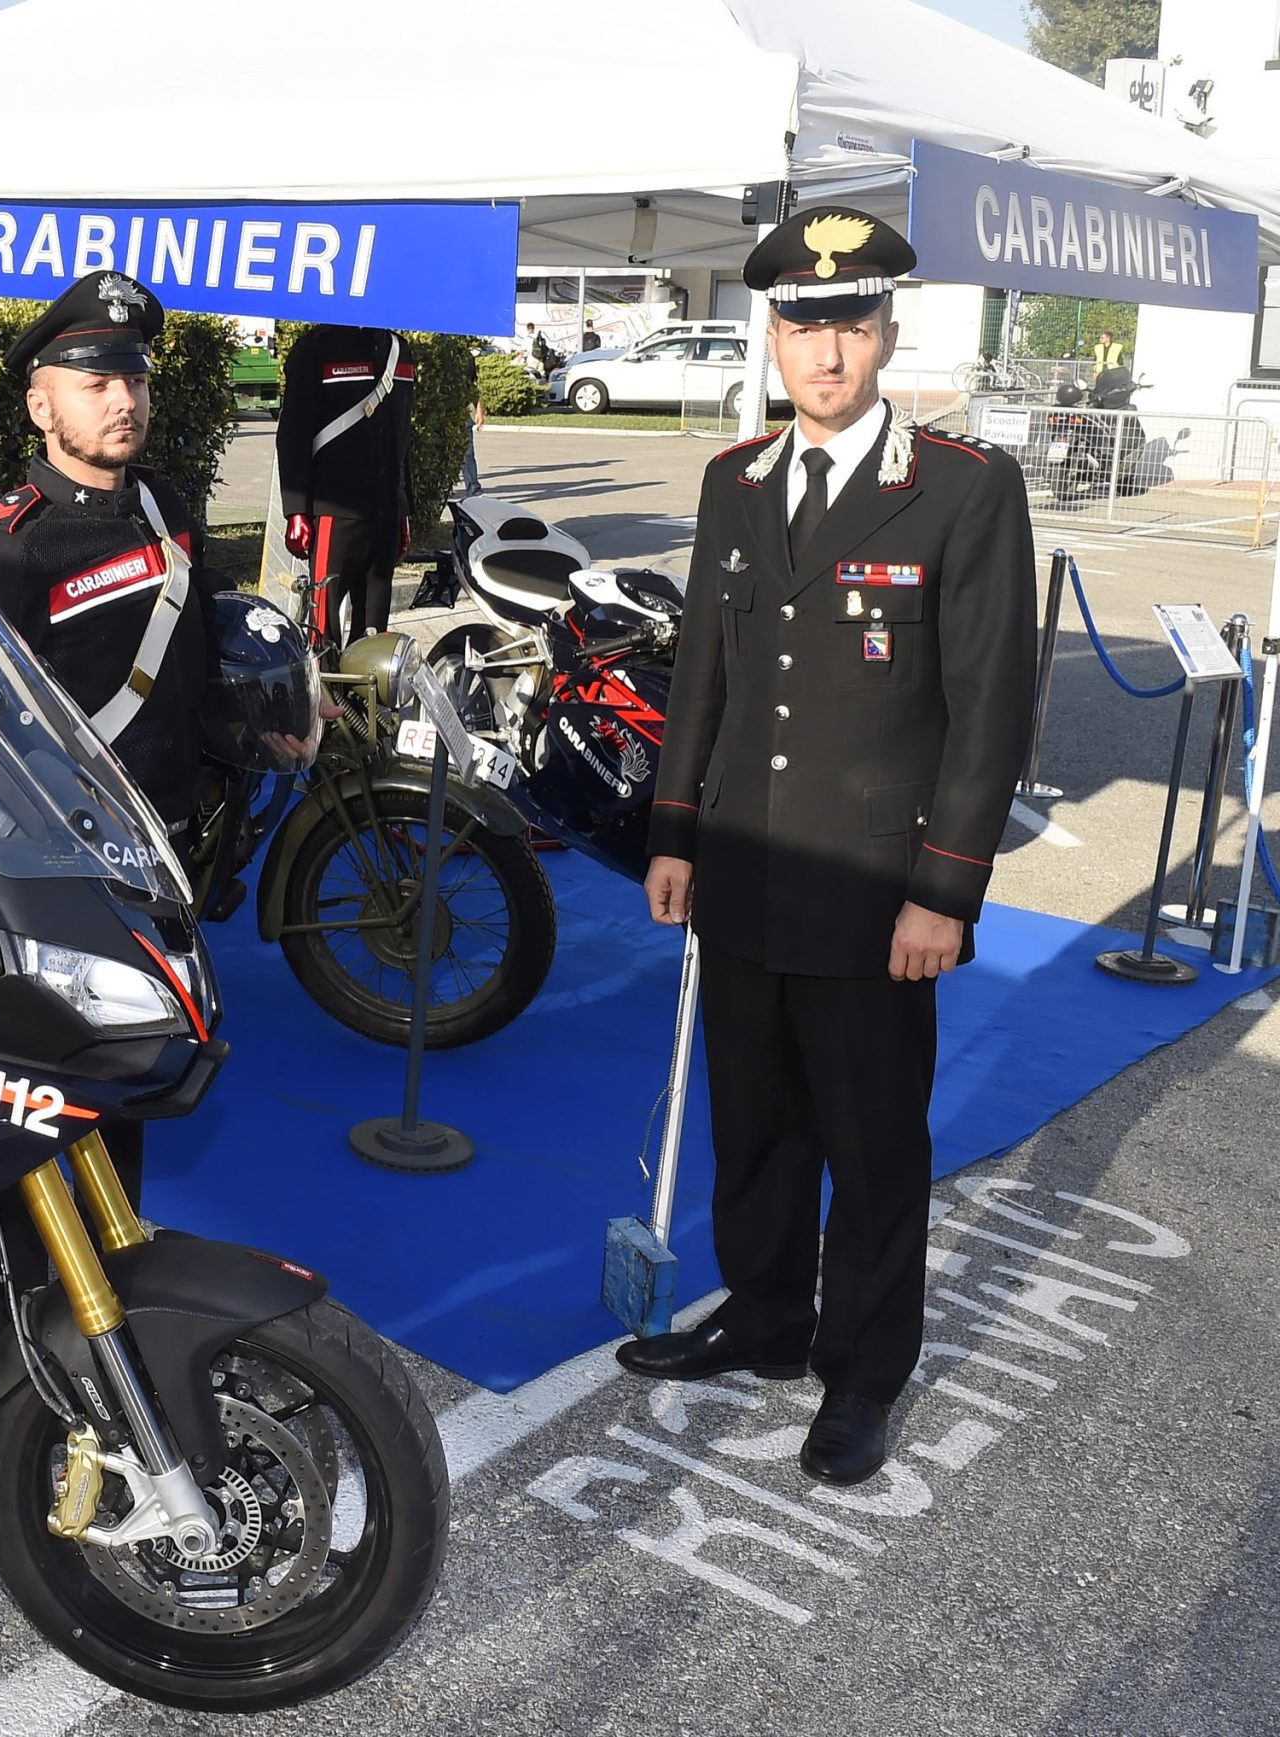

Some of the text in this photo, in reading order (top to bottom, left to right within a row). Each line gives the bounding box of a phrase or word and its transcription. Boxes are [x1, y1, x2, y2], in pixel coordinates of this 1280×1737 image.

[975, 184, 1212, 288] CARABINIERI
[984, 429, 1024, 443] Parking
[986, 415, 1026, 425] Scooter
[65, 557, 149, 598] CARABINIERI
[403, 728, 437, 751] RE
[558, 716, 628, 796] CARABINIERI
